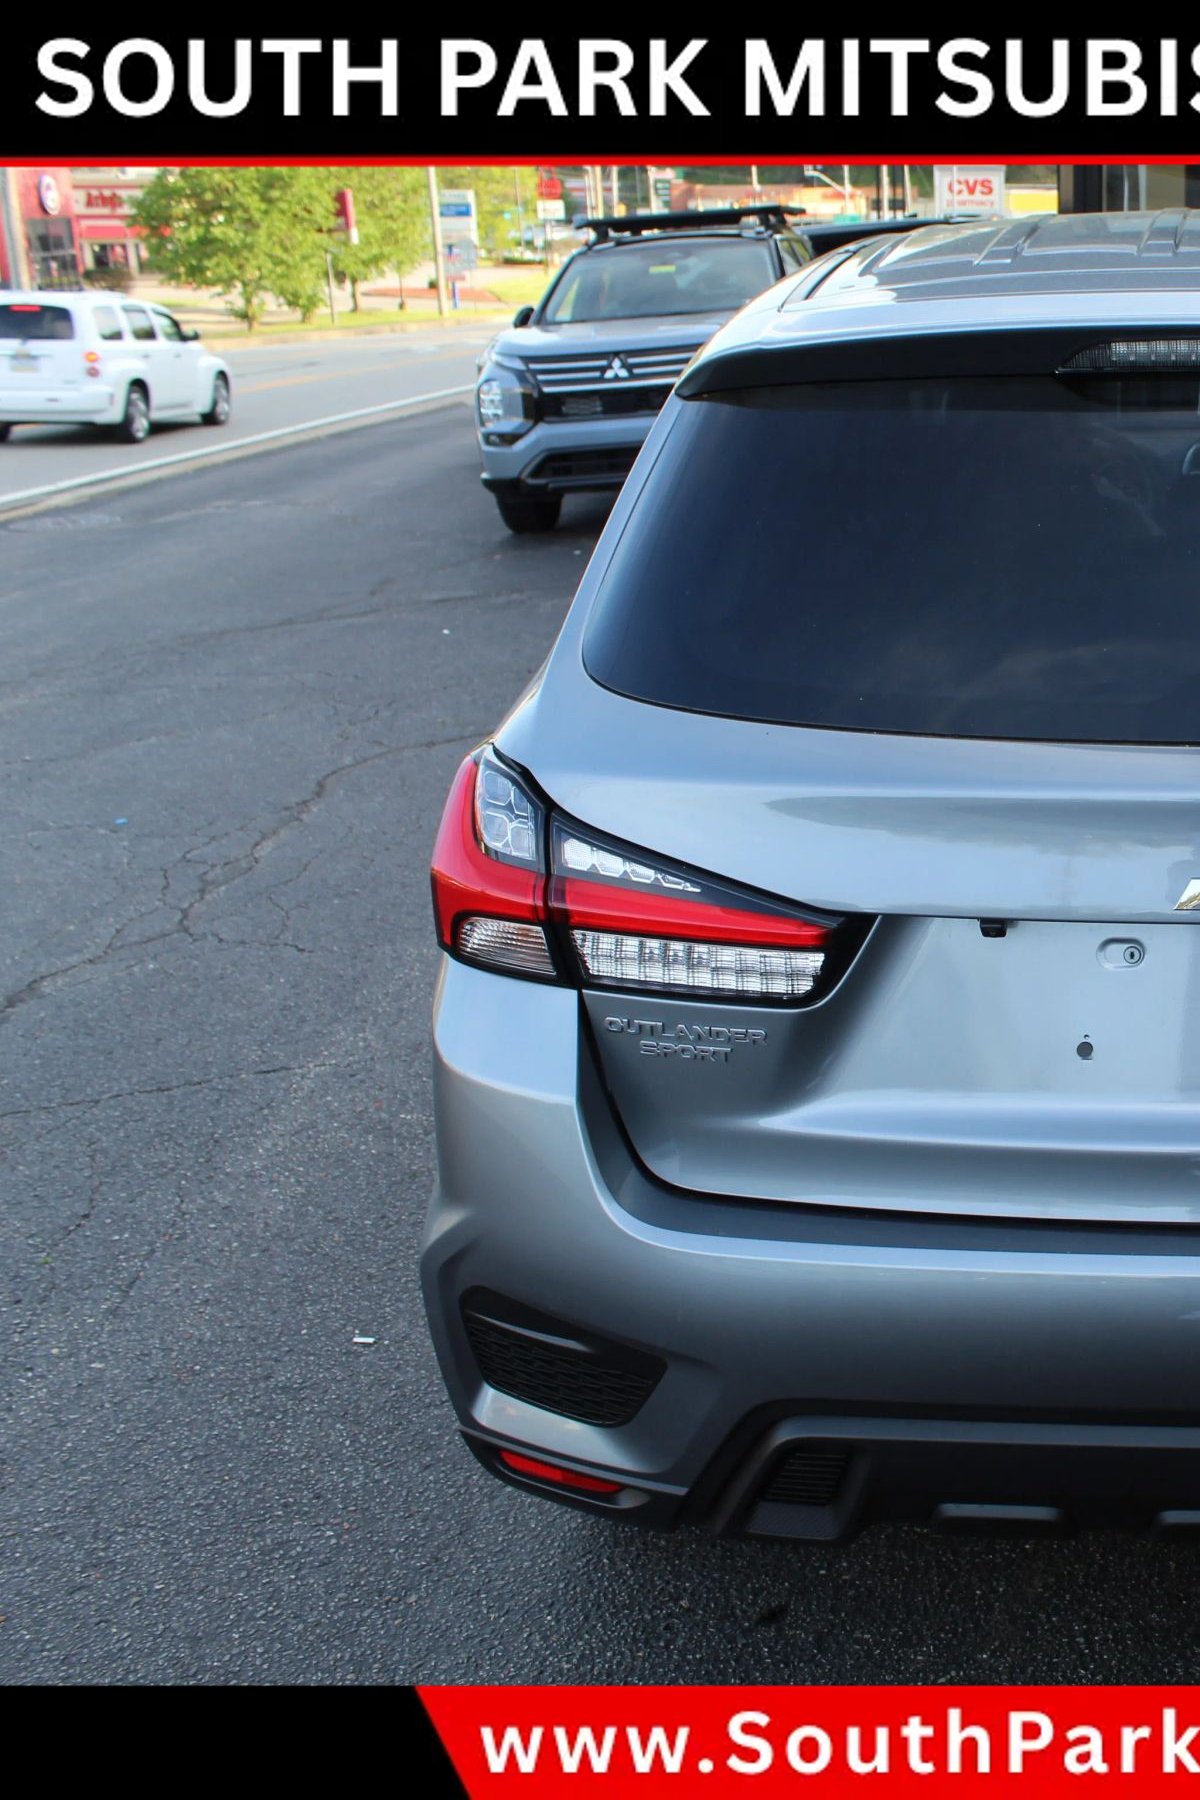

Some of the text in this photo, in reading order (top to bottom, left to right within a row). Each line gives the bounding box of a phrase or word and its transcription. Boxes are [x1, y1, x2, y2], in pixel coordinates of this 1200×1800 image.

[947, 177, 993, 196] CVS
[603, 1016, 768, 1046] OUTLANDER
[639, 1039, 733, 1063] SPORT
